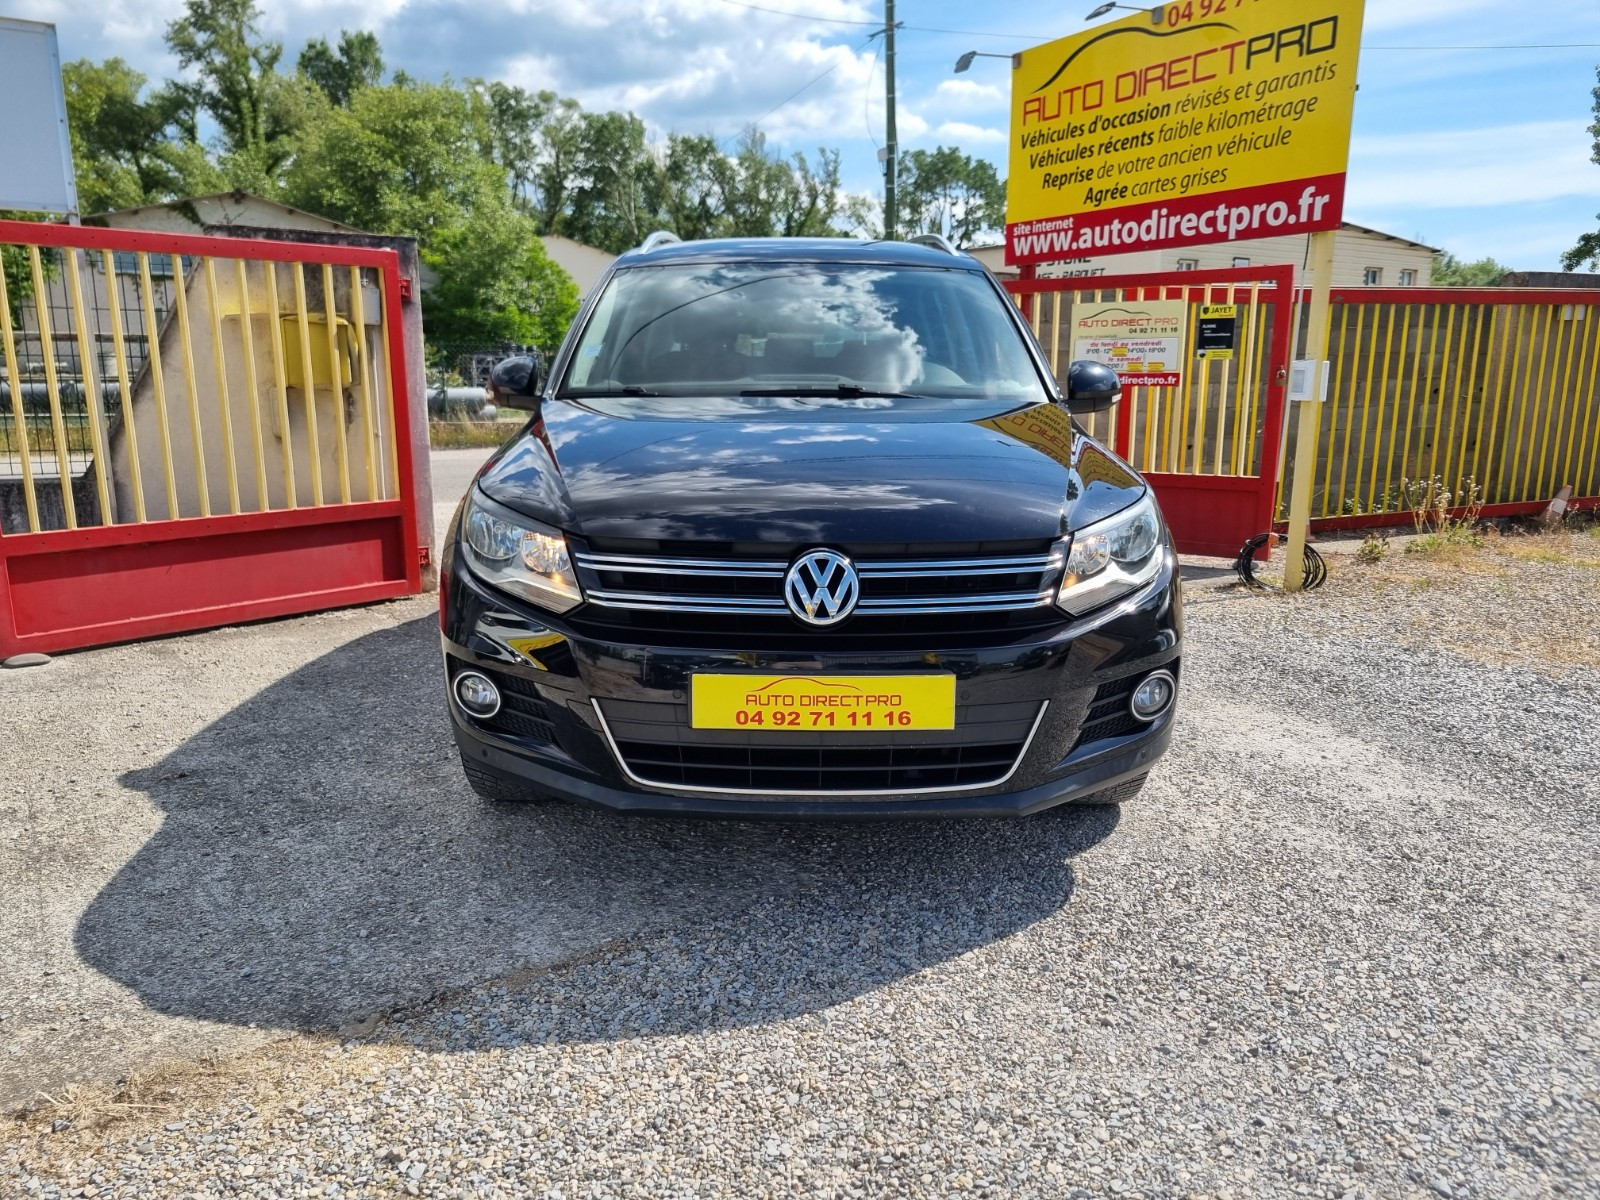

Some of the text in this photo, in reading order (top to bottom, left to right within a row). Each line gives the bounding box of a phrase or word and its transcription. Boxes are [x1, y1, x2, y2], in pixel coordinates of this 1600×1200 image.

[1168, 1, 1194, 27] 04
[1021, 60, 1337, 149] Véhicules d'occasion révisés et garantis
[1023, 80, 1104, 126] AUTO
[1030, 96, 1318, 169] Véhicules récents faible kilométrage
[1042, 125, 1293, 190] Reprise de votre ancien véhicule
[1084, 167, 1228, 207] Agrée cartes grises
[1013, 186, 1330, 257] www.autodirectpro.fr
[1013, 217, 1074, 236] site internet
[1078, 317, 1178, 328] AUTO DIRECT PRO
[1119, 376, 1177, 385] directpro.fr
[745, 694, 795, 706] AUTO
[735, 710, 911, 726] 04 92 71 11 16
